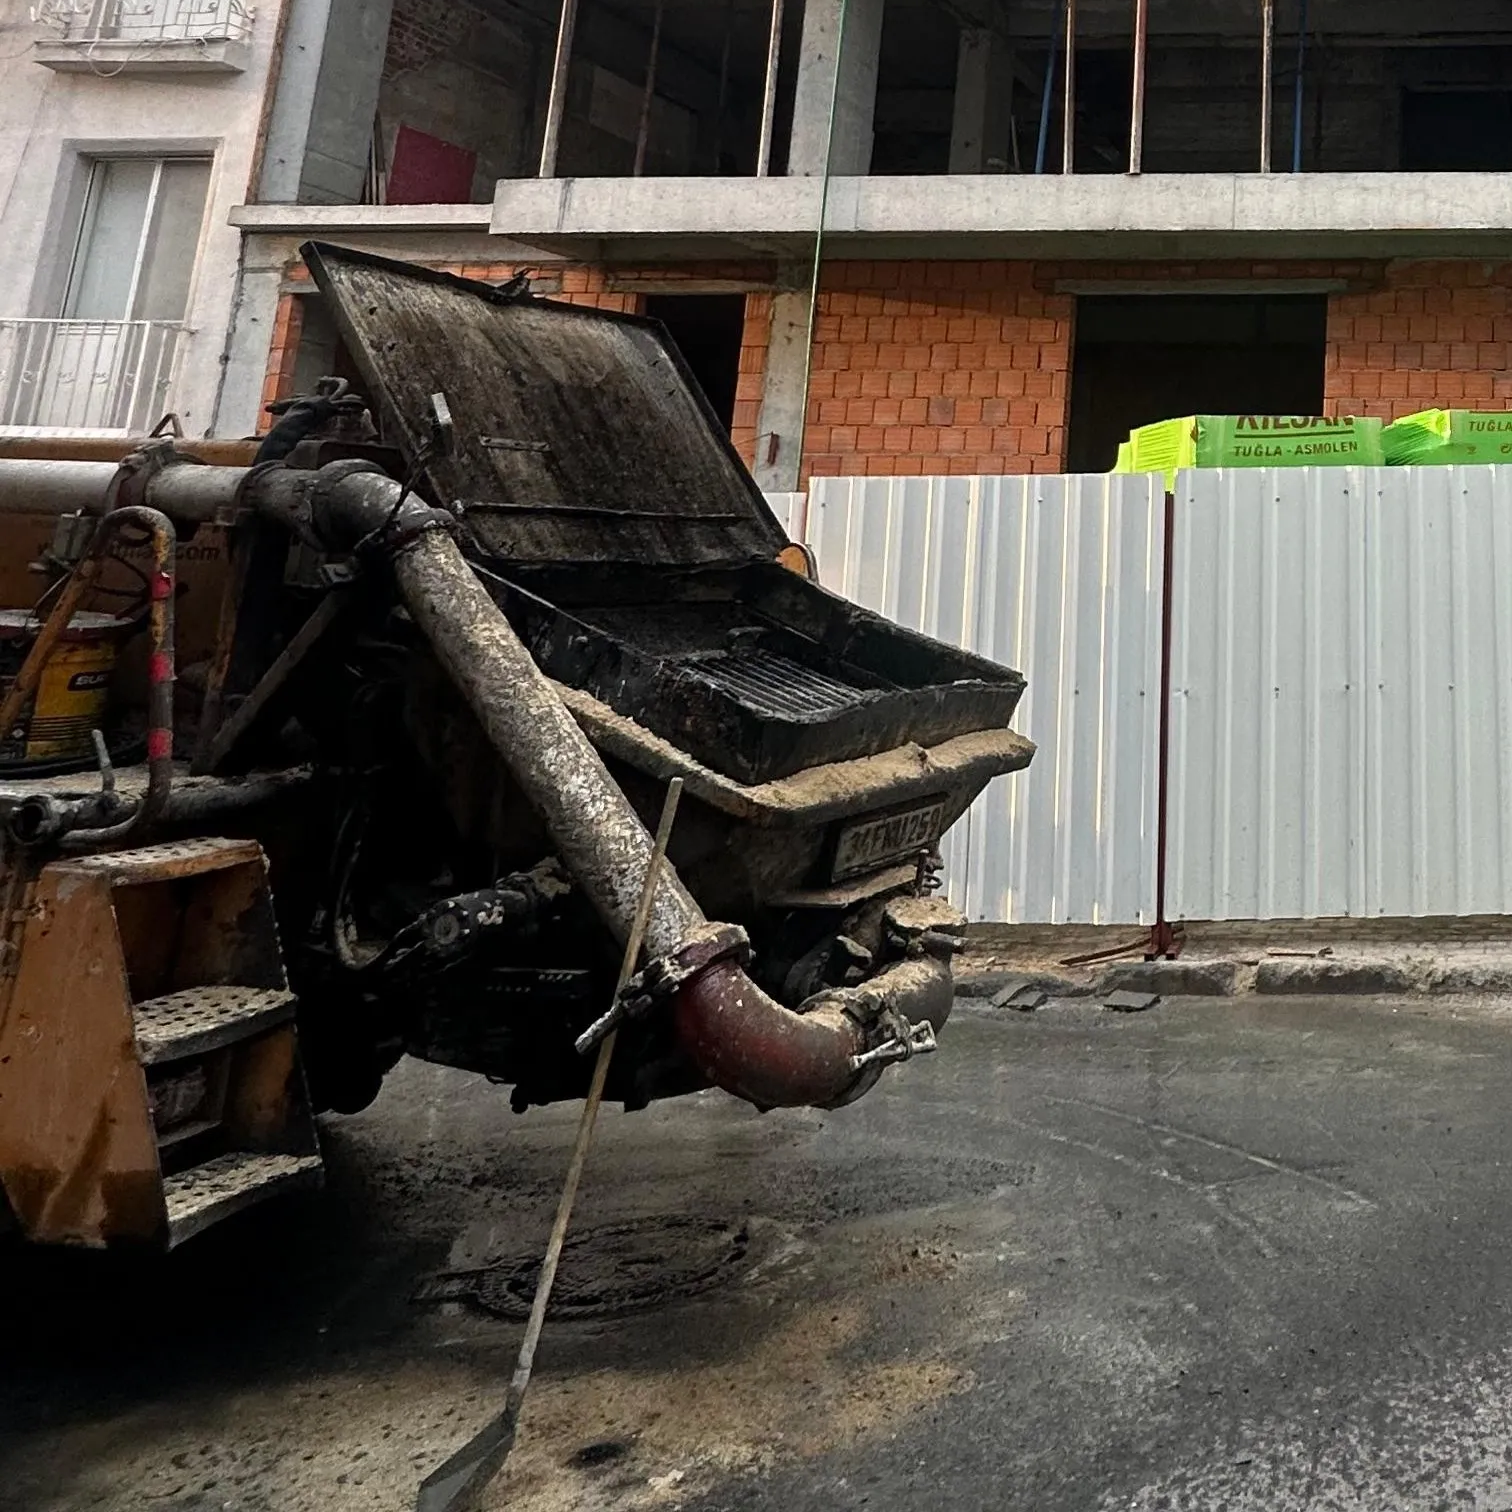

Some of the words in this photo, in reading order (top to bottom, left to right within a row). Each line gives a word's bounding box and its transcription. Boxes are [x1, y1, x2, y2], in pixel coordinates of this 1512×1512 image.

[1469, 420, 1512, 432] TUĞLA
[1234, 443, 1283, 457] TUĞLA
[1294, 441, 1358, 455] ASMOLEN
